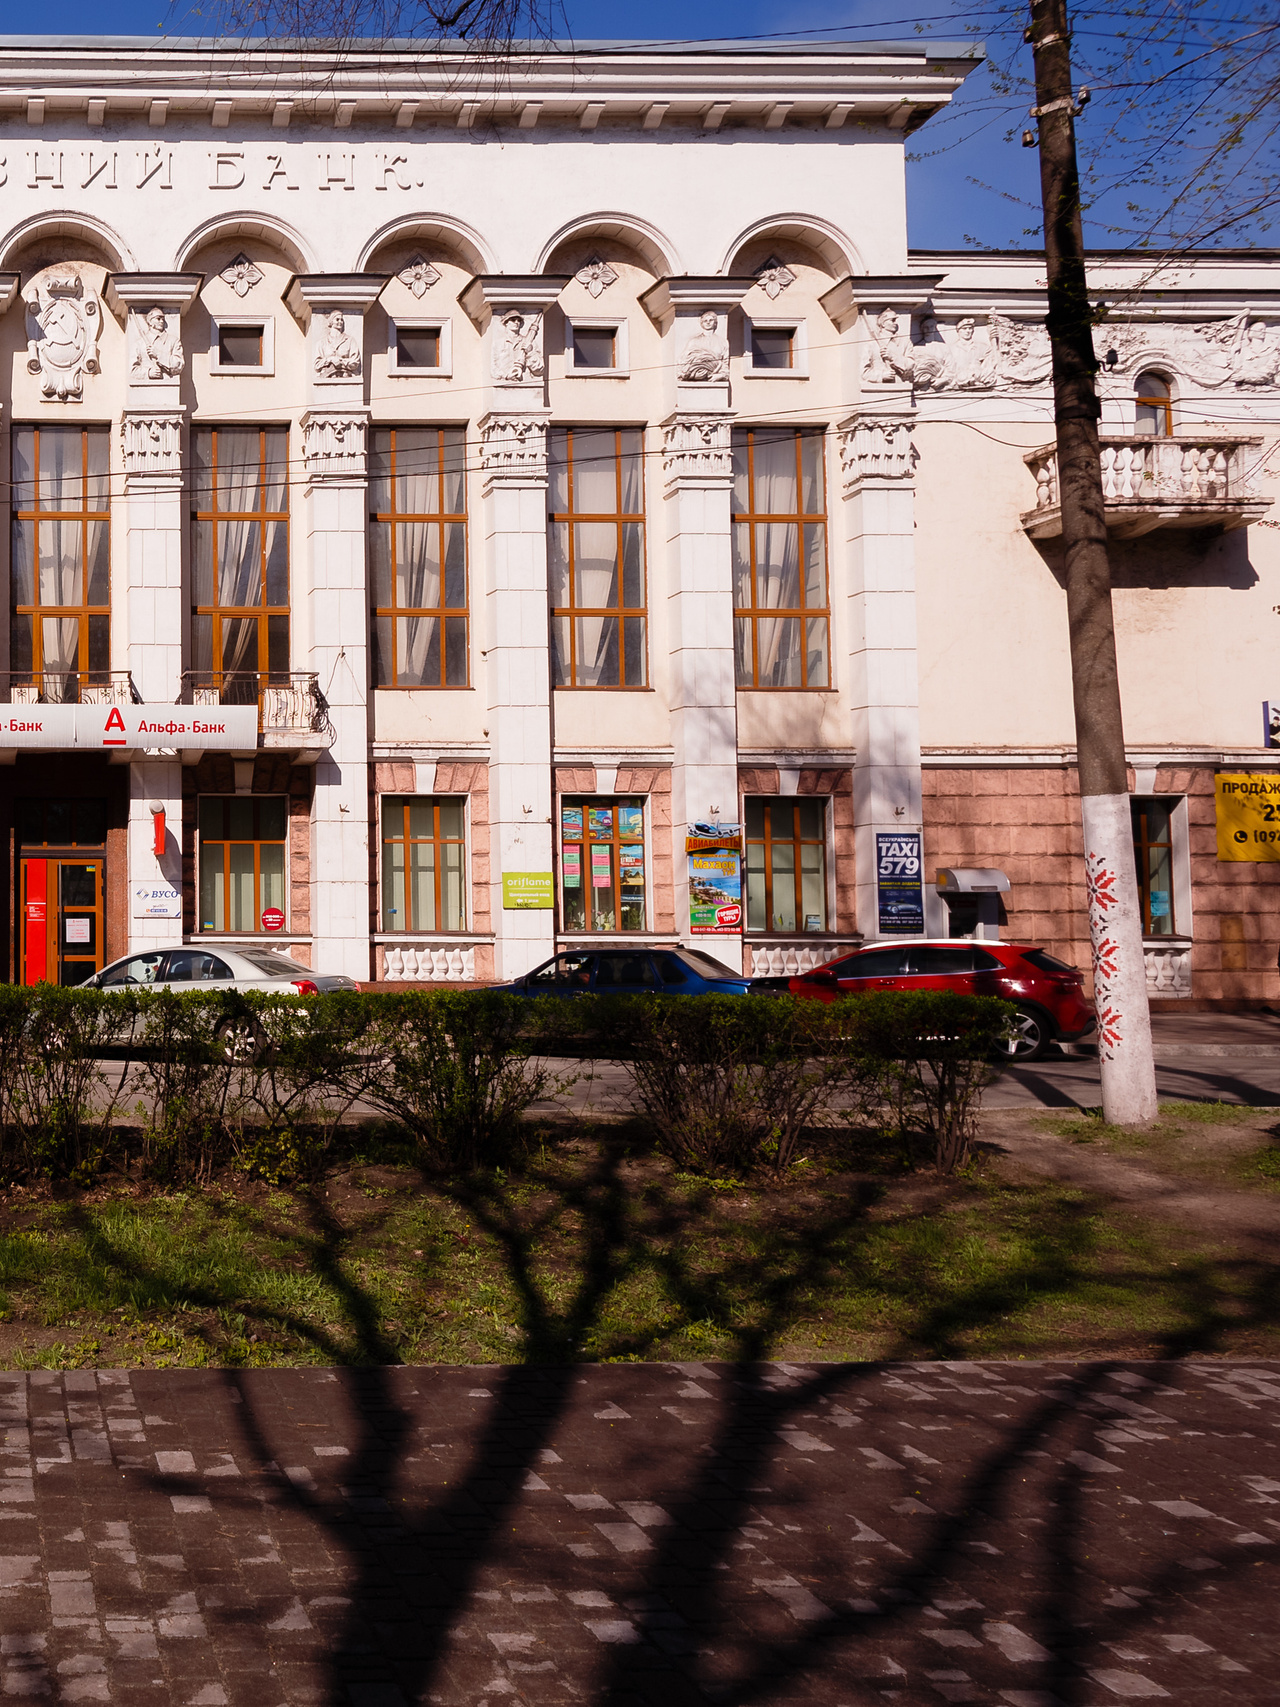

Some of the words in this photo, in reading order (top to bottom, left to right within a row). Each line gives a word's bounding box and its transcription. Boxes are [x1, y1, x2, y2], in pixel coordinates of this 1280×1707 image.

[688, 836, 741, 850] АВИАБИЛЕТЫ
[878, 842, 918, 856] TAXI
[693, 859, 736, 870] Махаон
[879, 857, 919, 874] 579
[507, 877, 551, 887] oriflame
[151, 890, 179, 898] ВУСО
